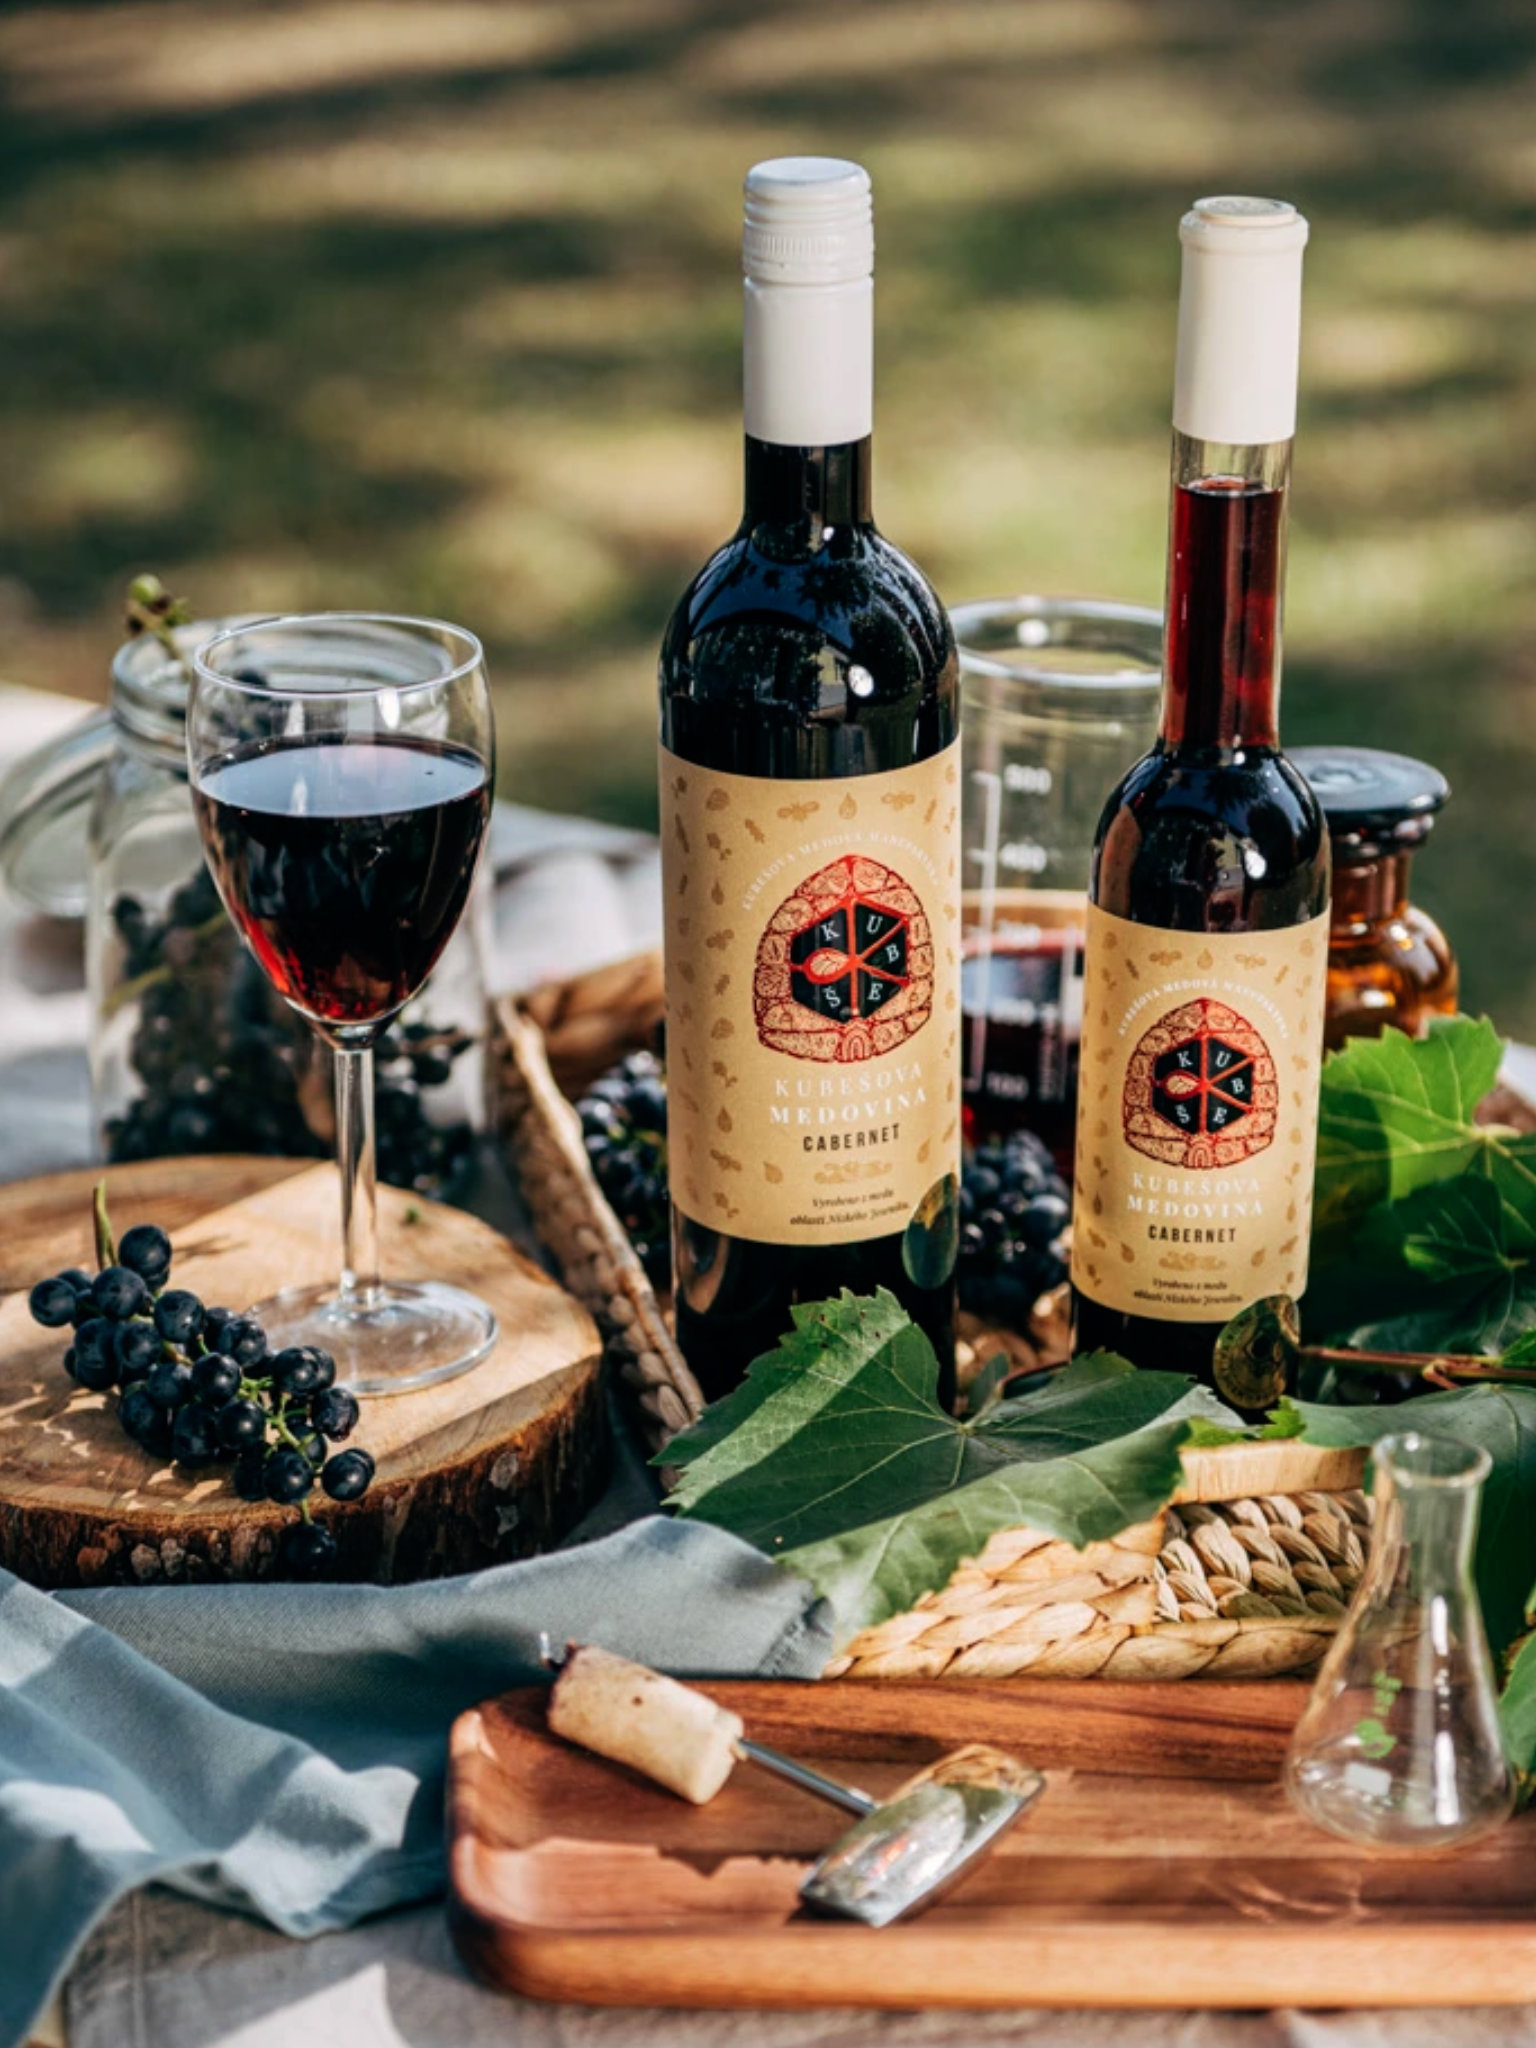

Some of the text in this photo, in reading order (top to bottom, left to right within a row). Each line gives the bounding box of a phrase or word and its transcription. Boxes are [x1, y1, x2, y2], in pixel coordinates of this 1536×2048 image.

[821, 920, 840, 942] K
[866, 914, 883, 935] U
[885, 943, 900, 964] B
[867, 982, 883, 1001] E
[1176, 1050, 1193, 1068] K
[1215, 1050, 1232, 1068] U
[775, 1061, 922, 1097] KUBEŠOVA
[1231, 1077, 1245, 1095] B
[769, 1086, 927, 1125] MEDOVINA
[1212, 1106, 1228, 1124] E
[803, 1122, 900, 1152] CABERNET
[1132, 1172, 1260, 1197] KUBEŠOVA
[1128, 1194, 1263, 1219] MEDOVINA
[1147, 1224, 1236, 1244] CABERNET
